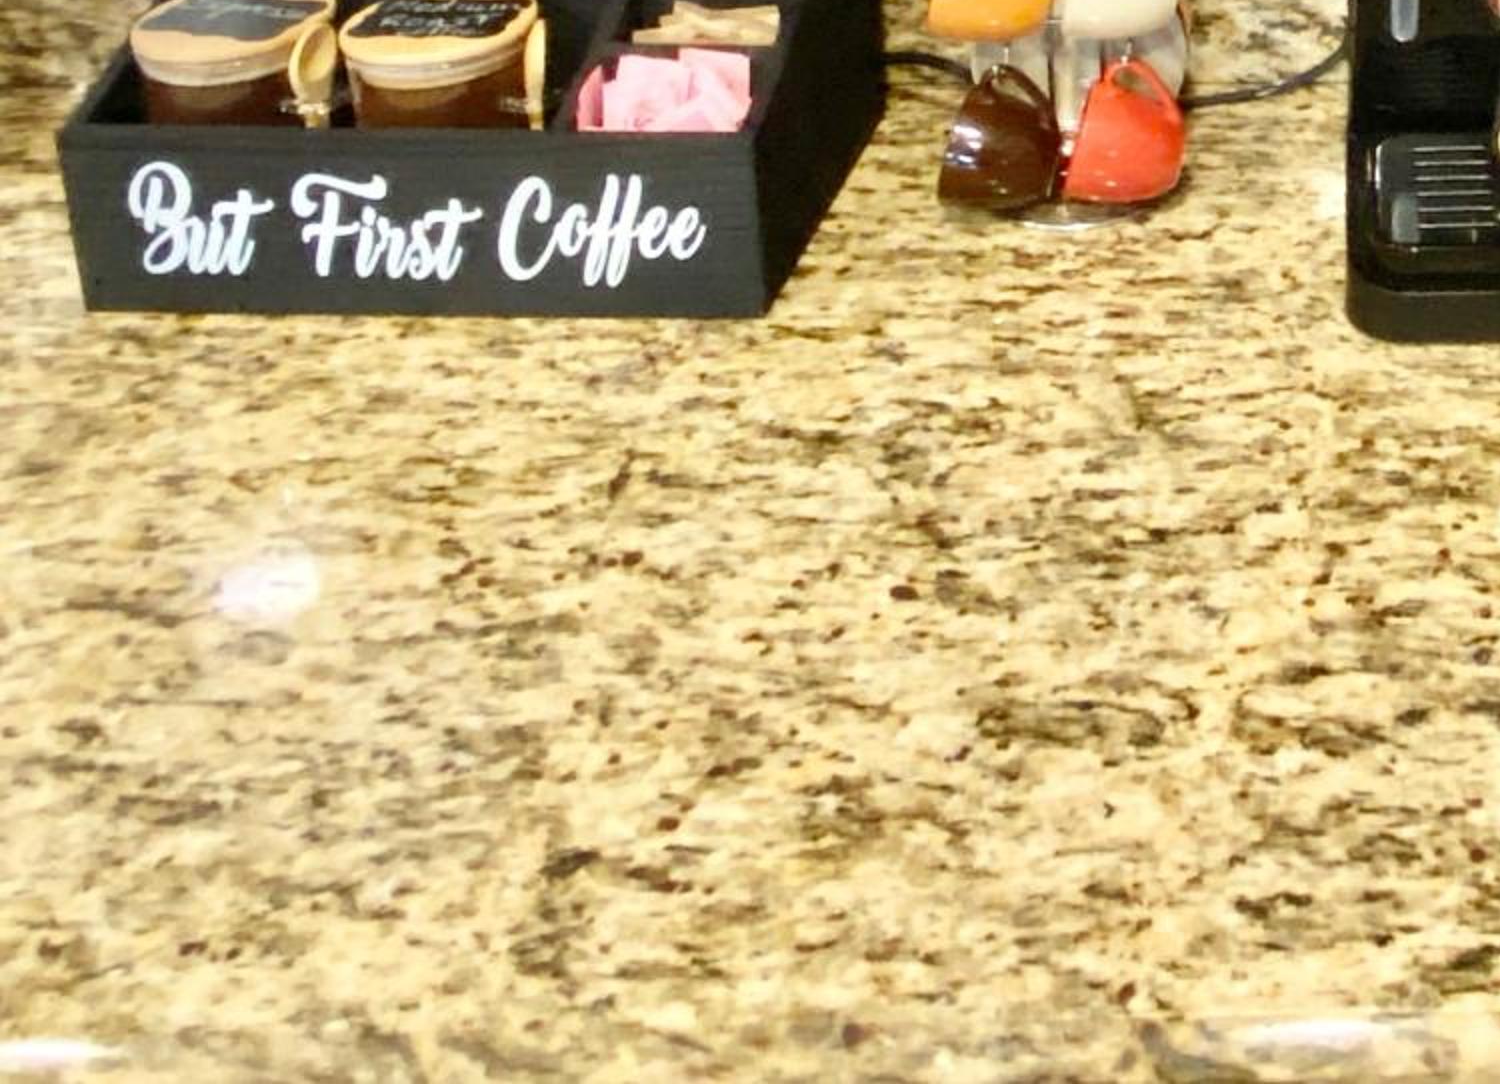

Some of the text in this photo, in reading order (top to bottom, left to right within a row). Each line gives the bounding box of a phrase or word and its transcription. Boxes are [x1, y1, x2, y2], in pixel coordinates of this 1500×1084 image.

[127, 160, 707, 289] But First Coffee
